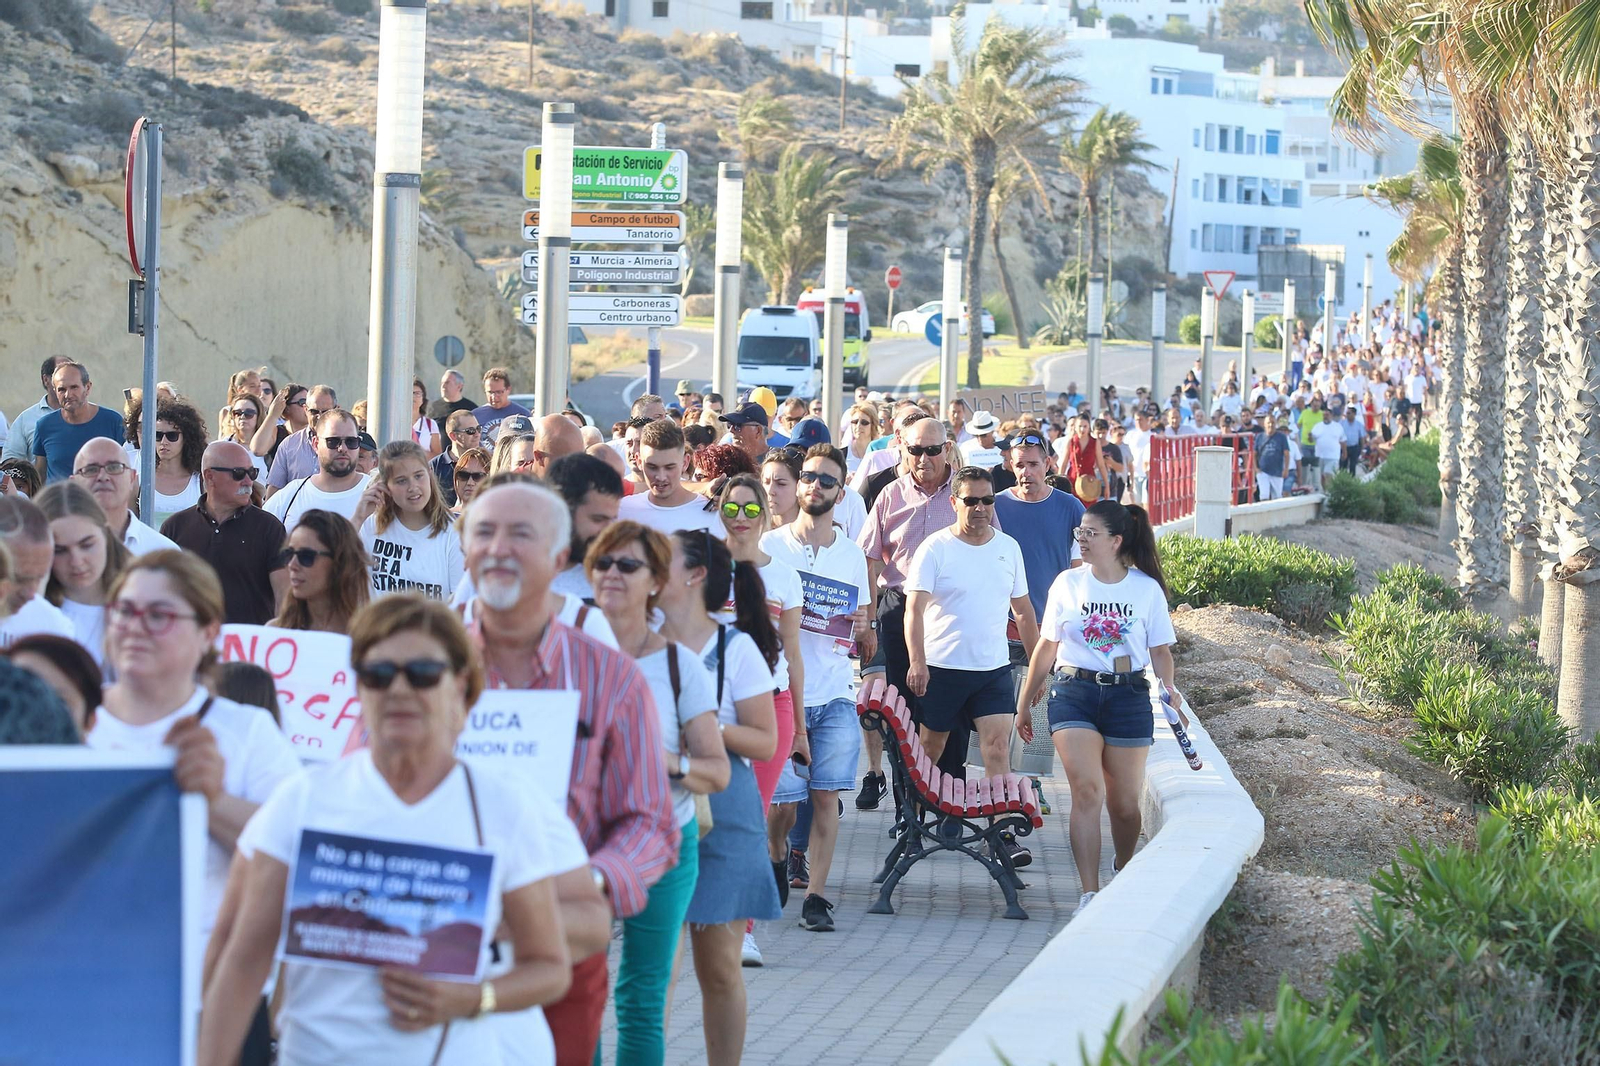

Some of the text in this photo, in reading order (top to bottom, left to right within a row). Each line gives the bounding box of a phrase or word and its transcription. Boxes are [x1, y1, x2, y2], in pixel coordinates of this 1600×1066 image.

[609, 156, 620, 169] de
[623, 155, 663, 170] Servicio
[669, 165, 679, 173] bp
[573, 173, 654, 187] an Antonio
[590, 214, 673, 225] Campo de futbol
[626, 229, 674, 239] Tanatorio
[591, 256, 625, 266] Murcia
[577, 270, 673, 281] Polígono Industrial
[613, 298, 671, 308] Carboneras
[600, 312, 671, 323] Centro urbano
[372, 539, 412, 561] DON'T
[372, 555, 401, 576] BE A
[808, 580, 815, 589] la
[816, 584, 838, 595] carga
[840, 588, 849, 598] de
[802, 589, 849, 607] ral de hierro
[1080, 602, 1133, 618] SPRING
[223, 634, 298, 679] NO
[332, 671, 347, 686] A
[513, 743, 538, 757] DE
[315, 843, 470, 882] No a la carga de
